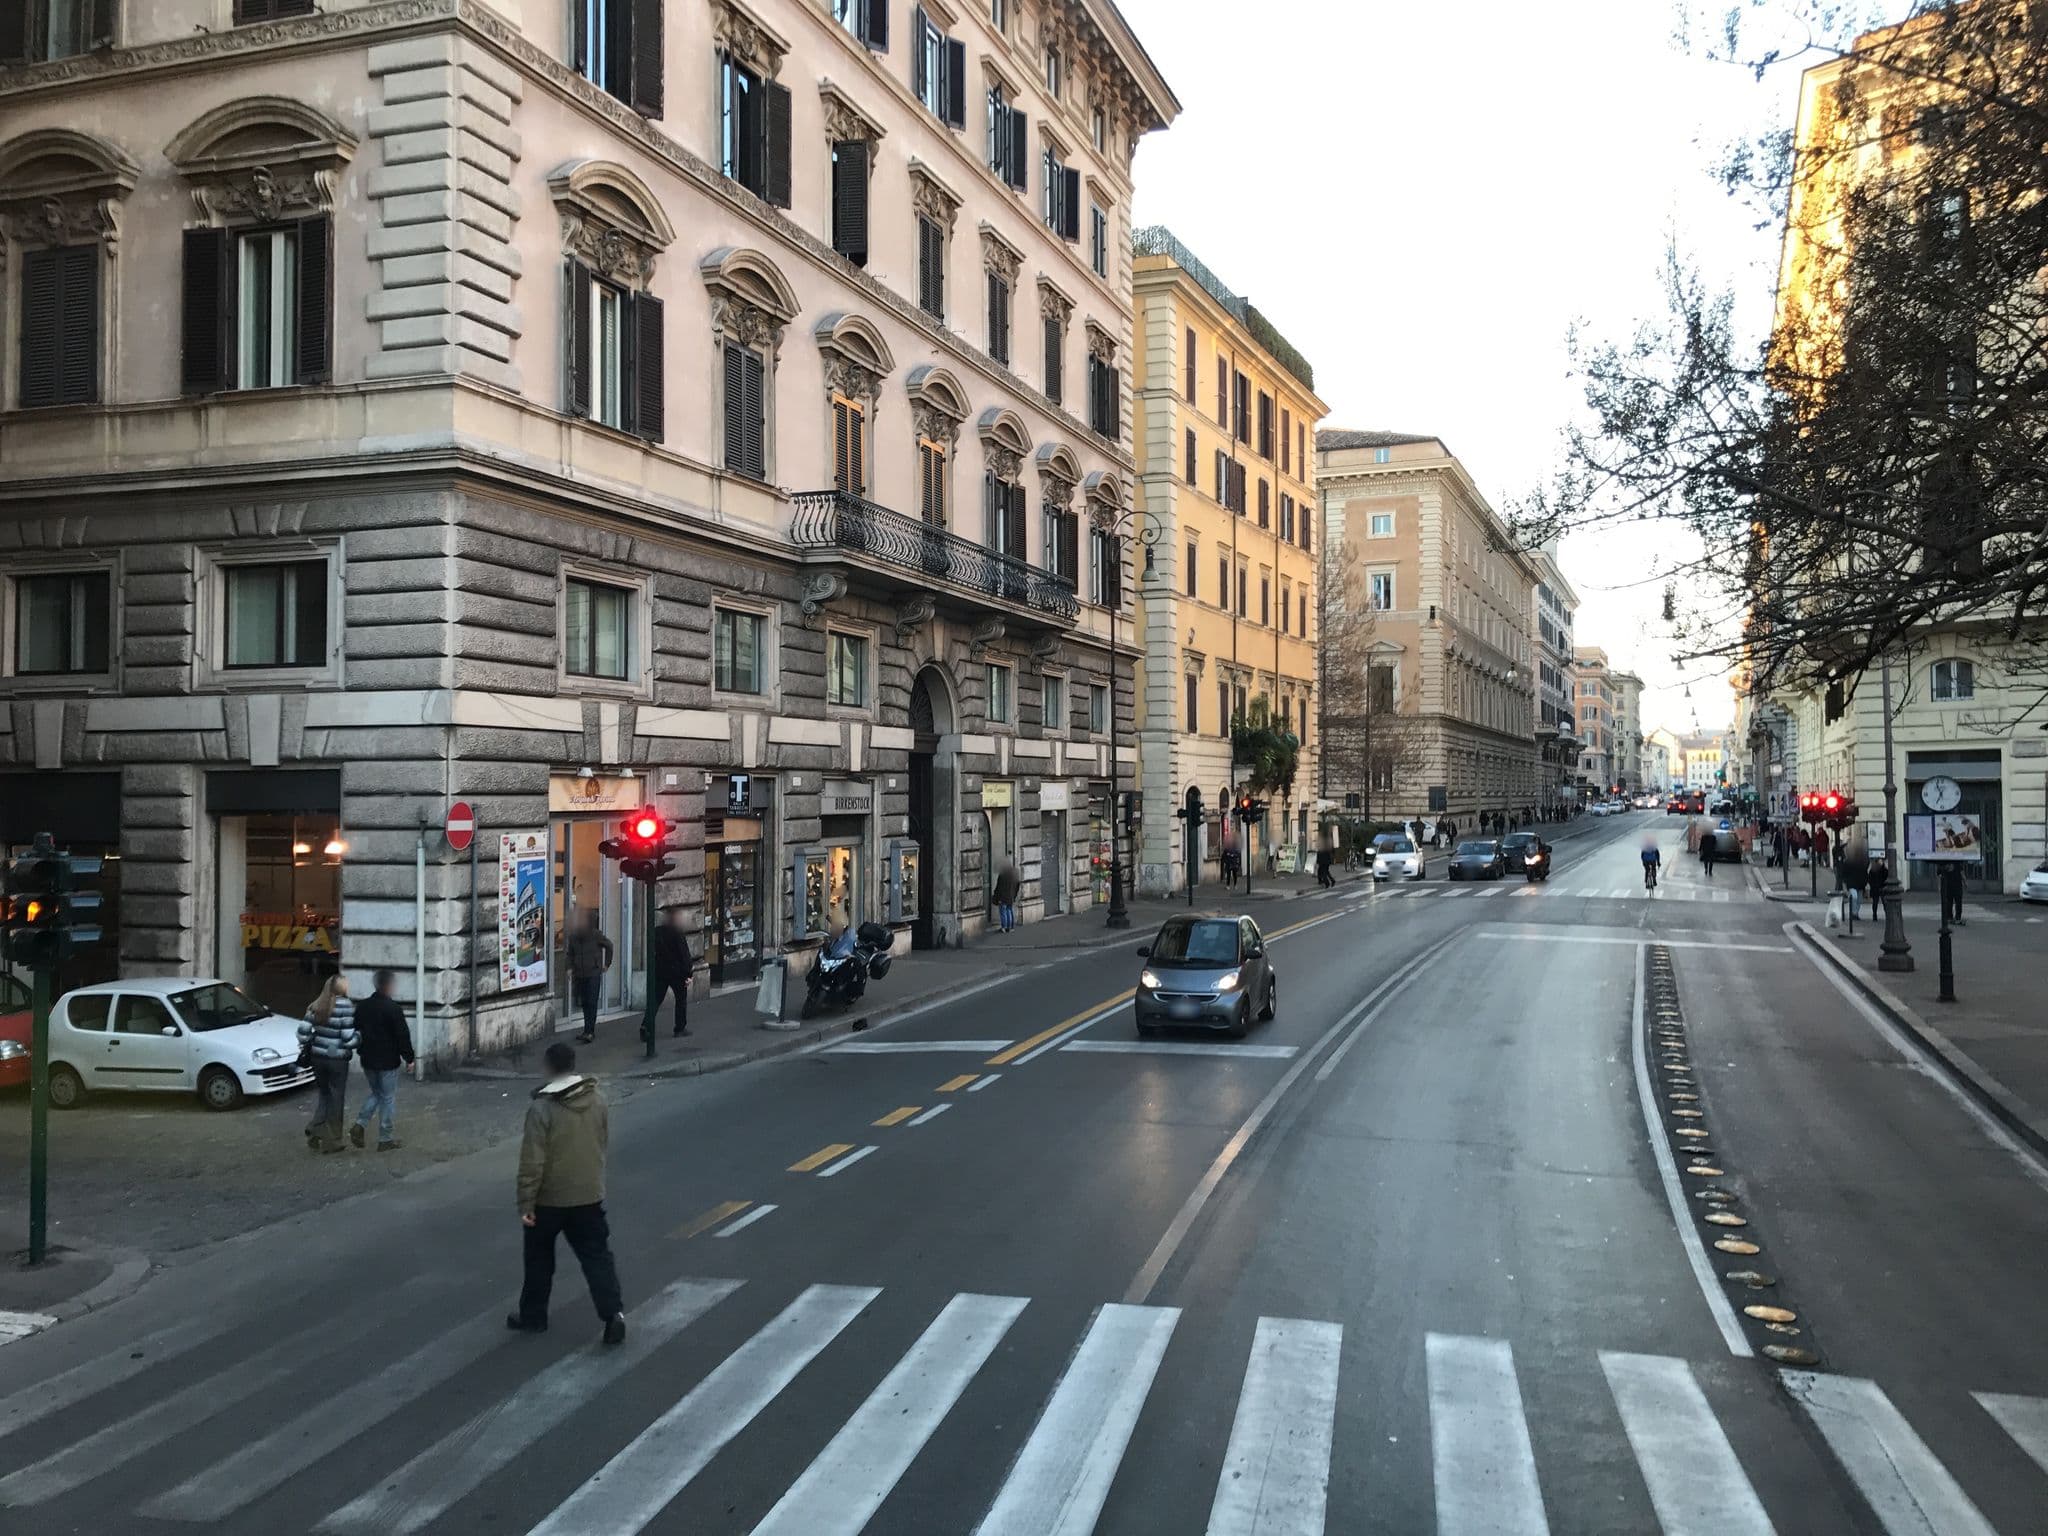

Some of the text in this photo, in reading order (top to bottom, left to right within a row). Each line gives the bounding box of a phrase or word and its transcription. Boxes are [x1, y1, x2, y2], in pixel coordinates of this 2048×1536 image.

[731, 776, 748, 802] T
[835, 796, 870, 810] BIRKENSTOCK
[240, 924, 334, 952] PIZZA
